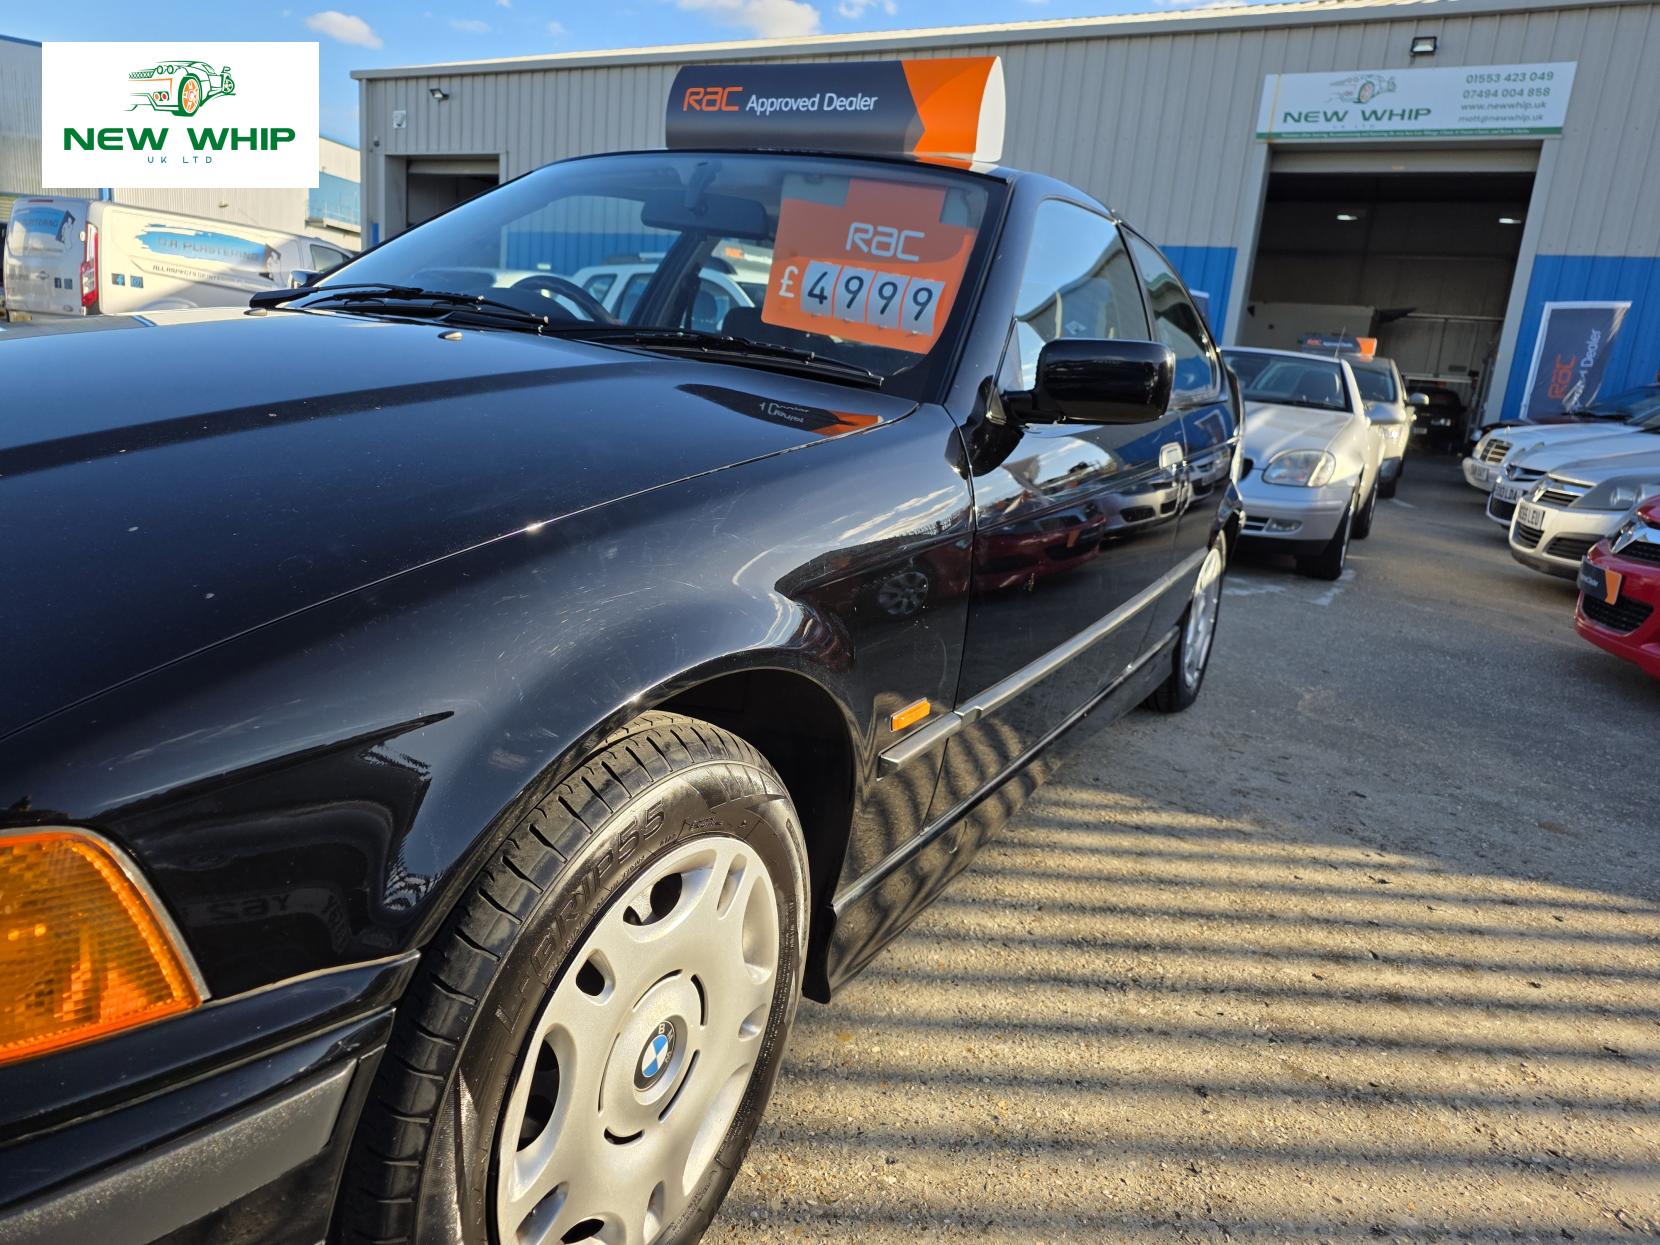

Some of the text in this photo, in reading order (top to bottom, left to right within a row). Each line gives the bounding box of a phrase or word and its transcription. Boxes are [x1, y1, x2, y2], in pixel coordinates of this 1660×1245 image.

[1465, 71, 1554, 84] 01553 423 049
[1462, 87, 1551, 99] 07494 004 858
[746, 93, 821, 116] Approved
[823, 93, 878, 112] Dealer
[1282, 107, 1432, 124] NEW WHIP
[657, 1022, 676, 1064] BMW
